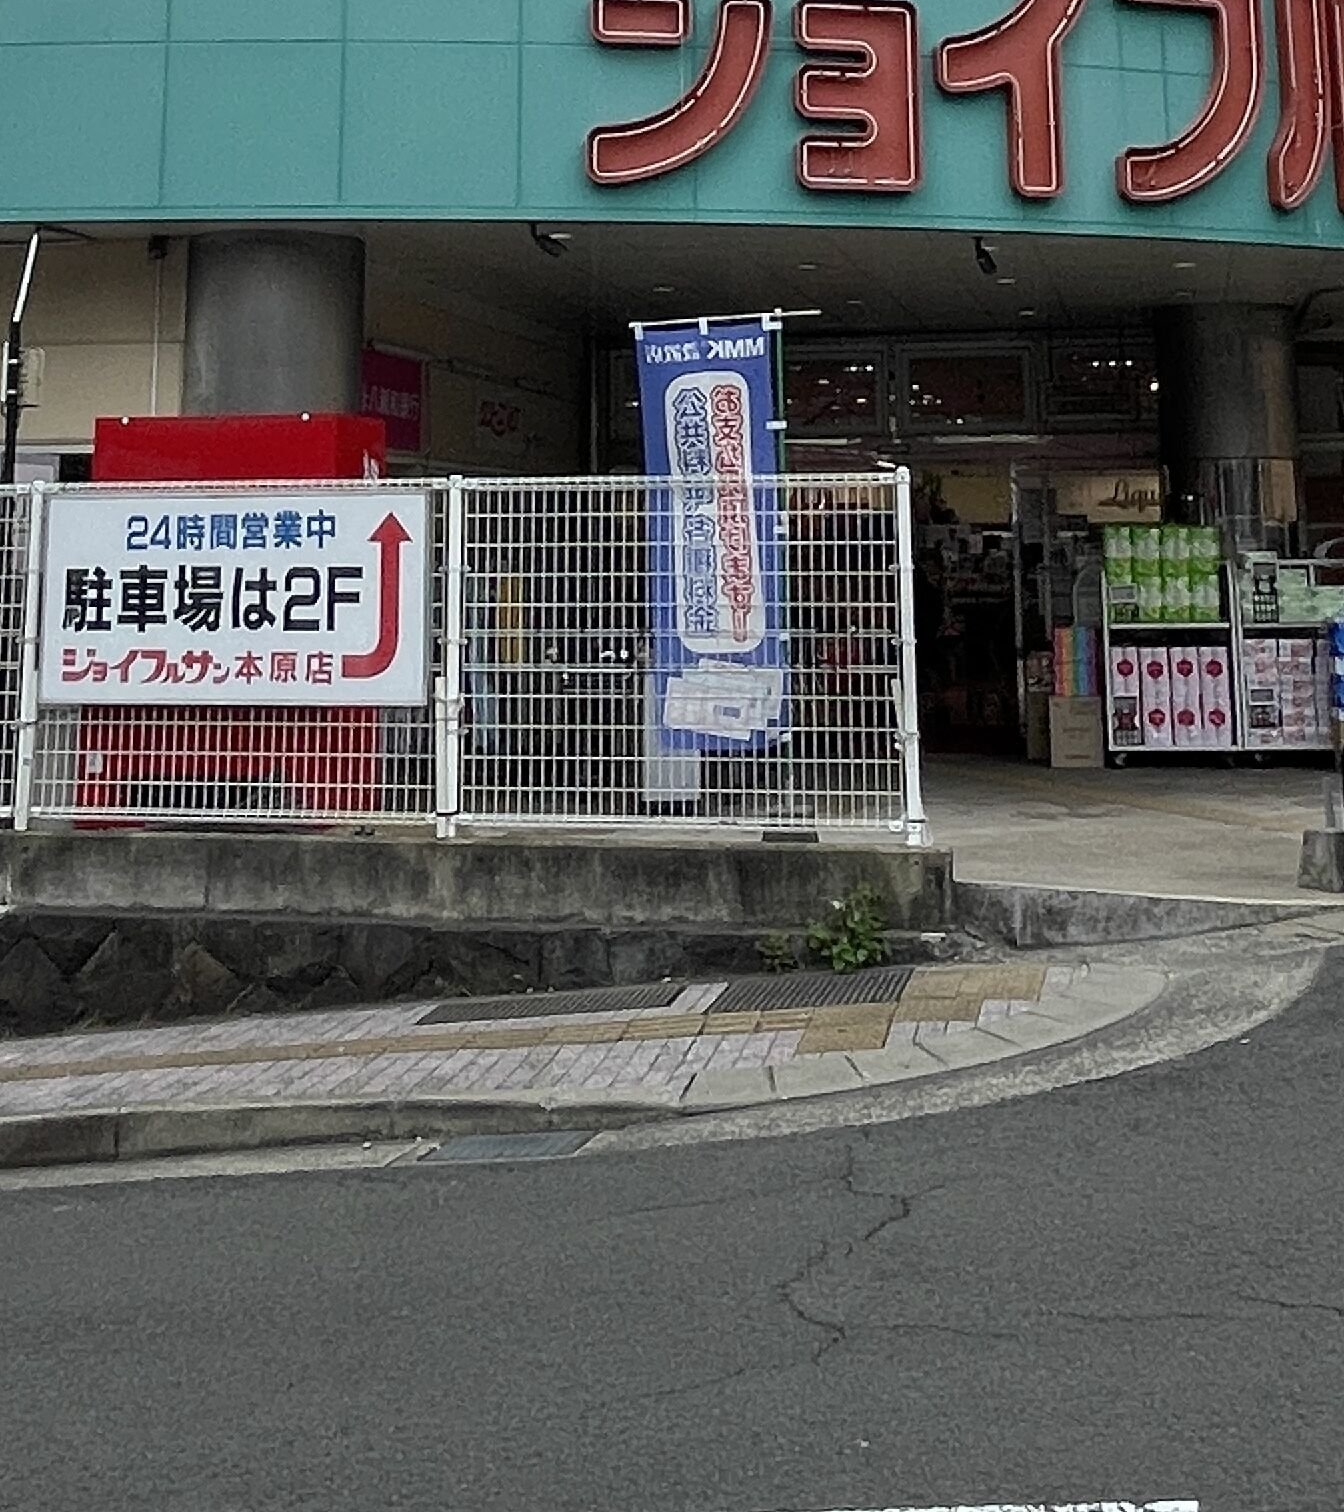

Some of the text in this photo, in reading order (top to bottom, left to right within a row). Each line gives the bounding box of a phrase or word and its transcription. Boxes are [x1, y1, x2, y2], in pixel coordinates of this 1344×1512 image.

[126, 509, 336, 550] 24時間営業中
[62, 564, 364, 632] 駐車場は2F
[61, 648, 334, 684] ジョイフルサン本原店
